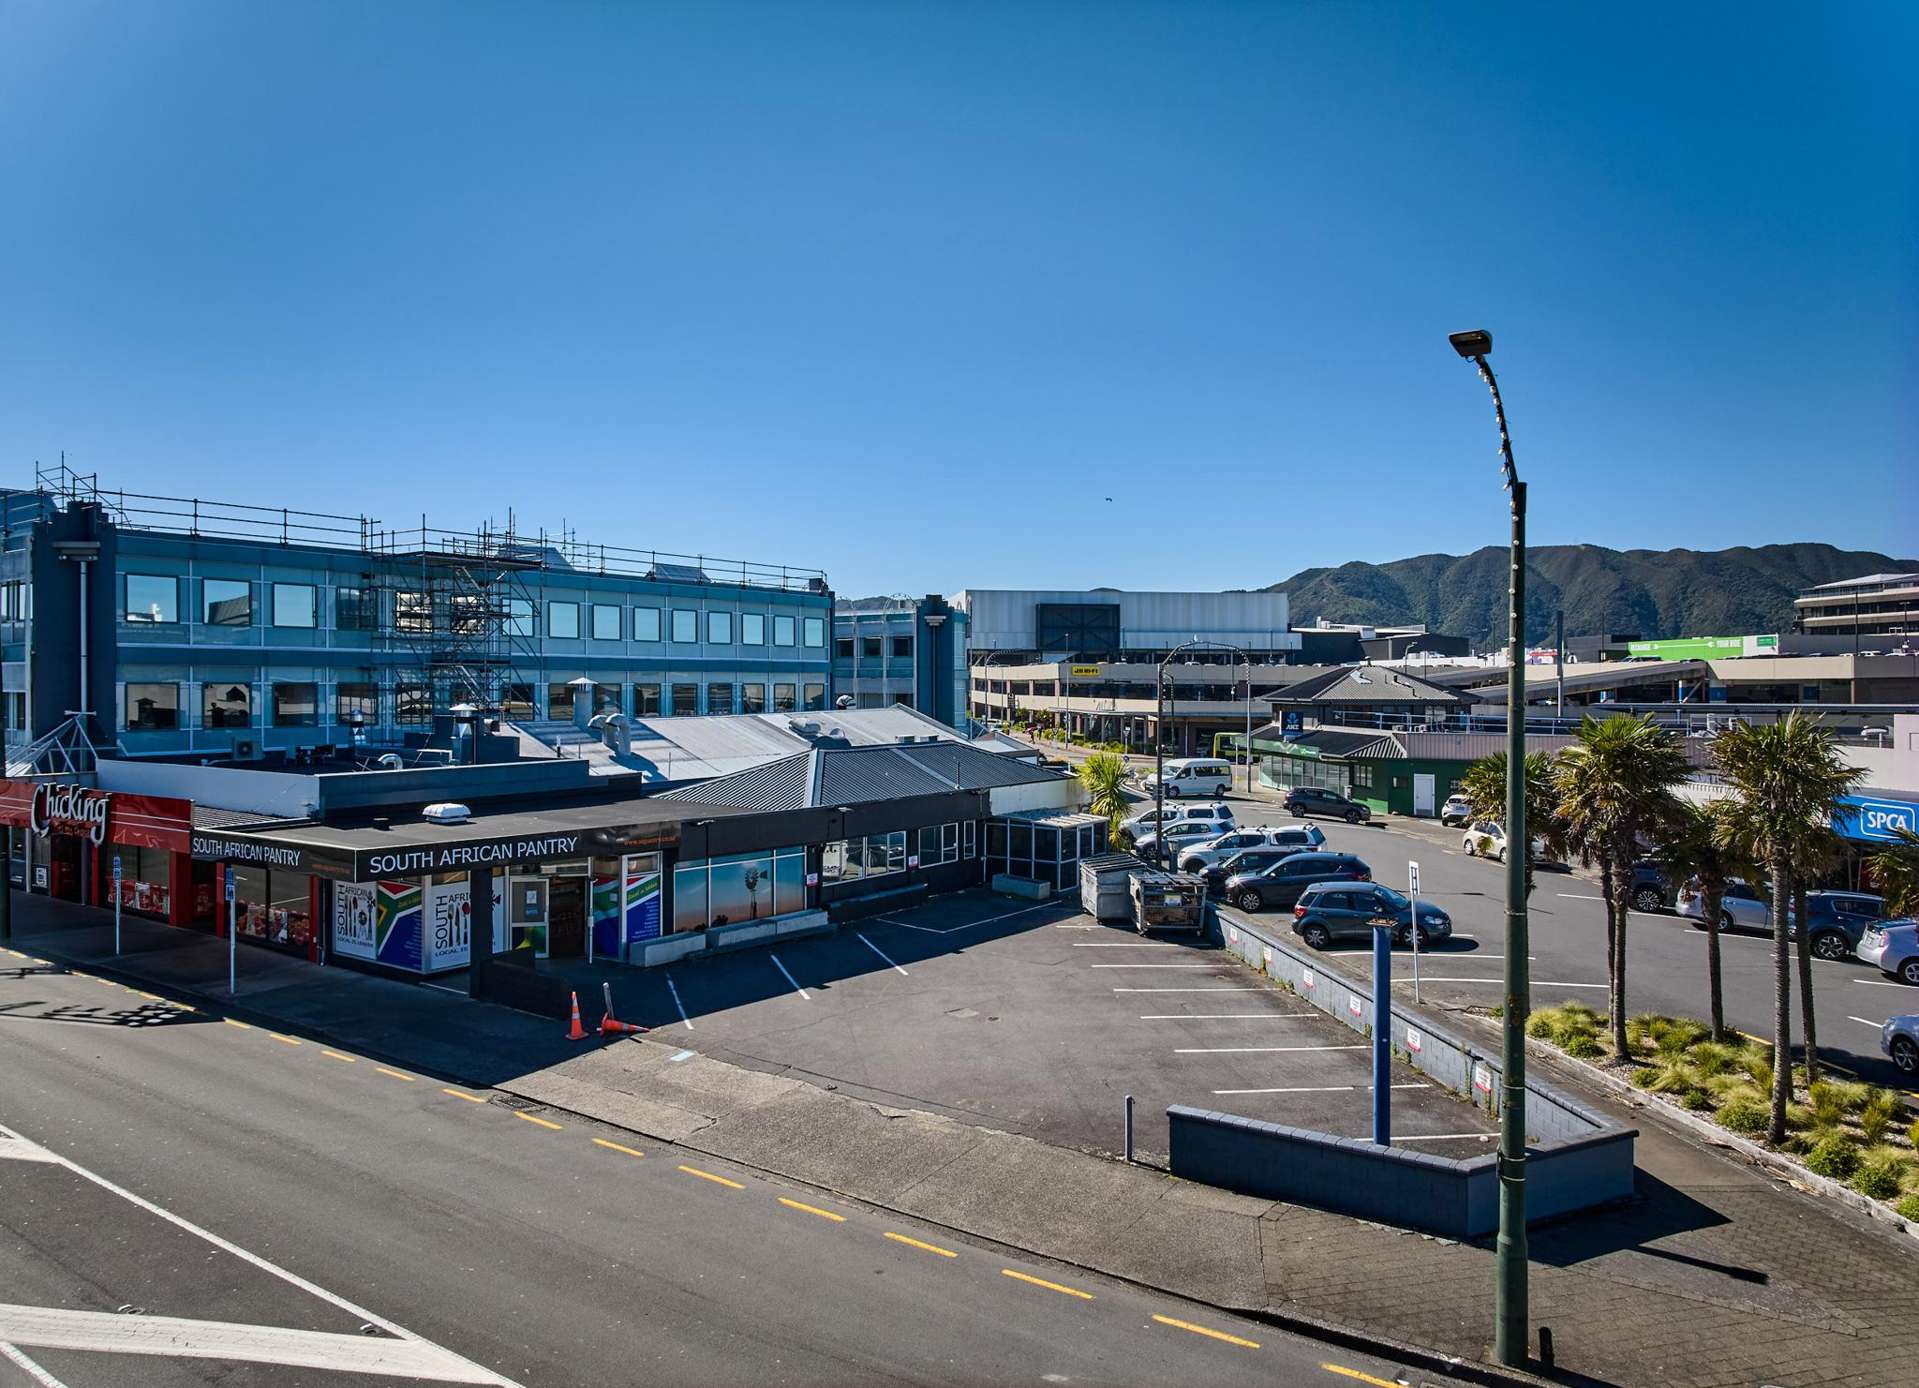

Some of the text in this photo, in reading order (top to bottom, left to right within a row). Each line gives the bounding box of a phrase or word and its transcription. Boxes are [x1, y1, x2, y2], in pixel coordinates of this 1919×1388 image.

[1867, 811, 1908, 833] SPCA
[192, 837, 301, 866] SOUTH AFRICAN PANTRY
[369, 851, 434, 873] SOUTH
[439, 844, 513, 867] AFRICAN
[517, 836, 578, 858] PANTRY
[337, 884, 345, 936] SOUTH
[448, 892, 471, 904] AFRI
[435, 895, 448, 950] SOUTH
